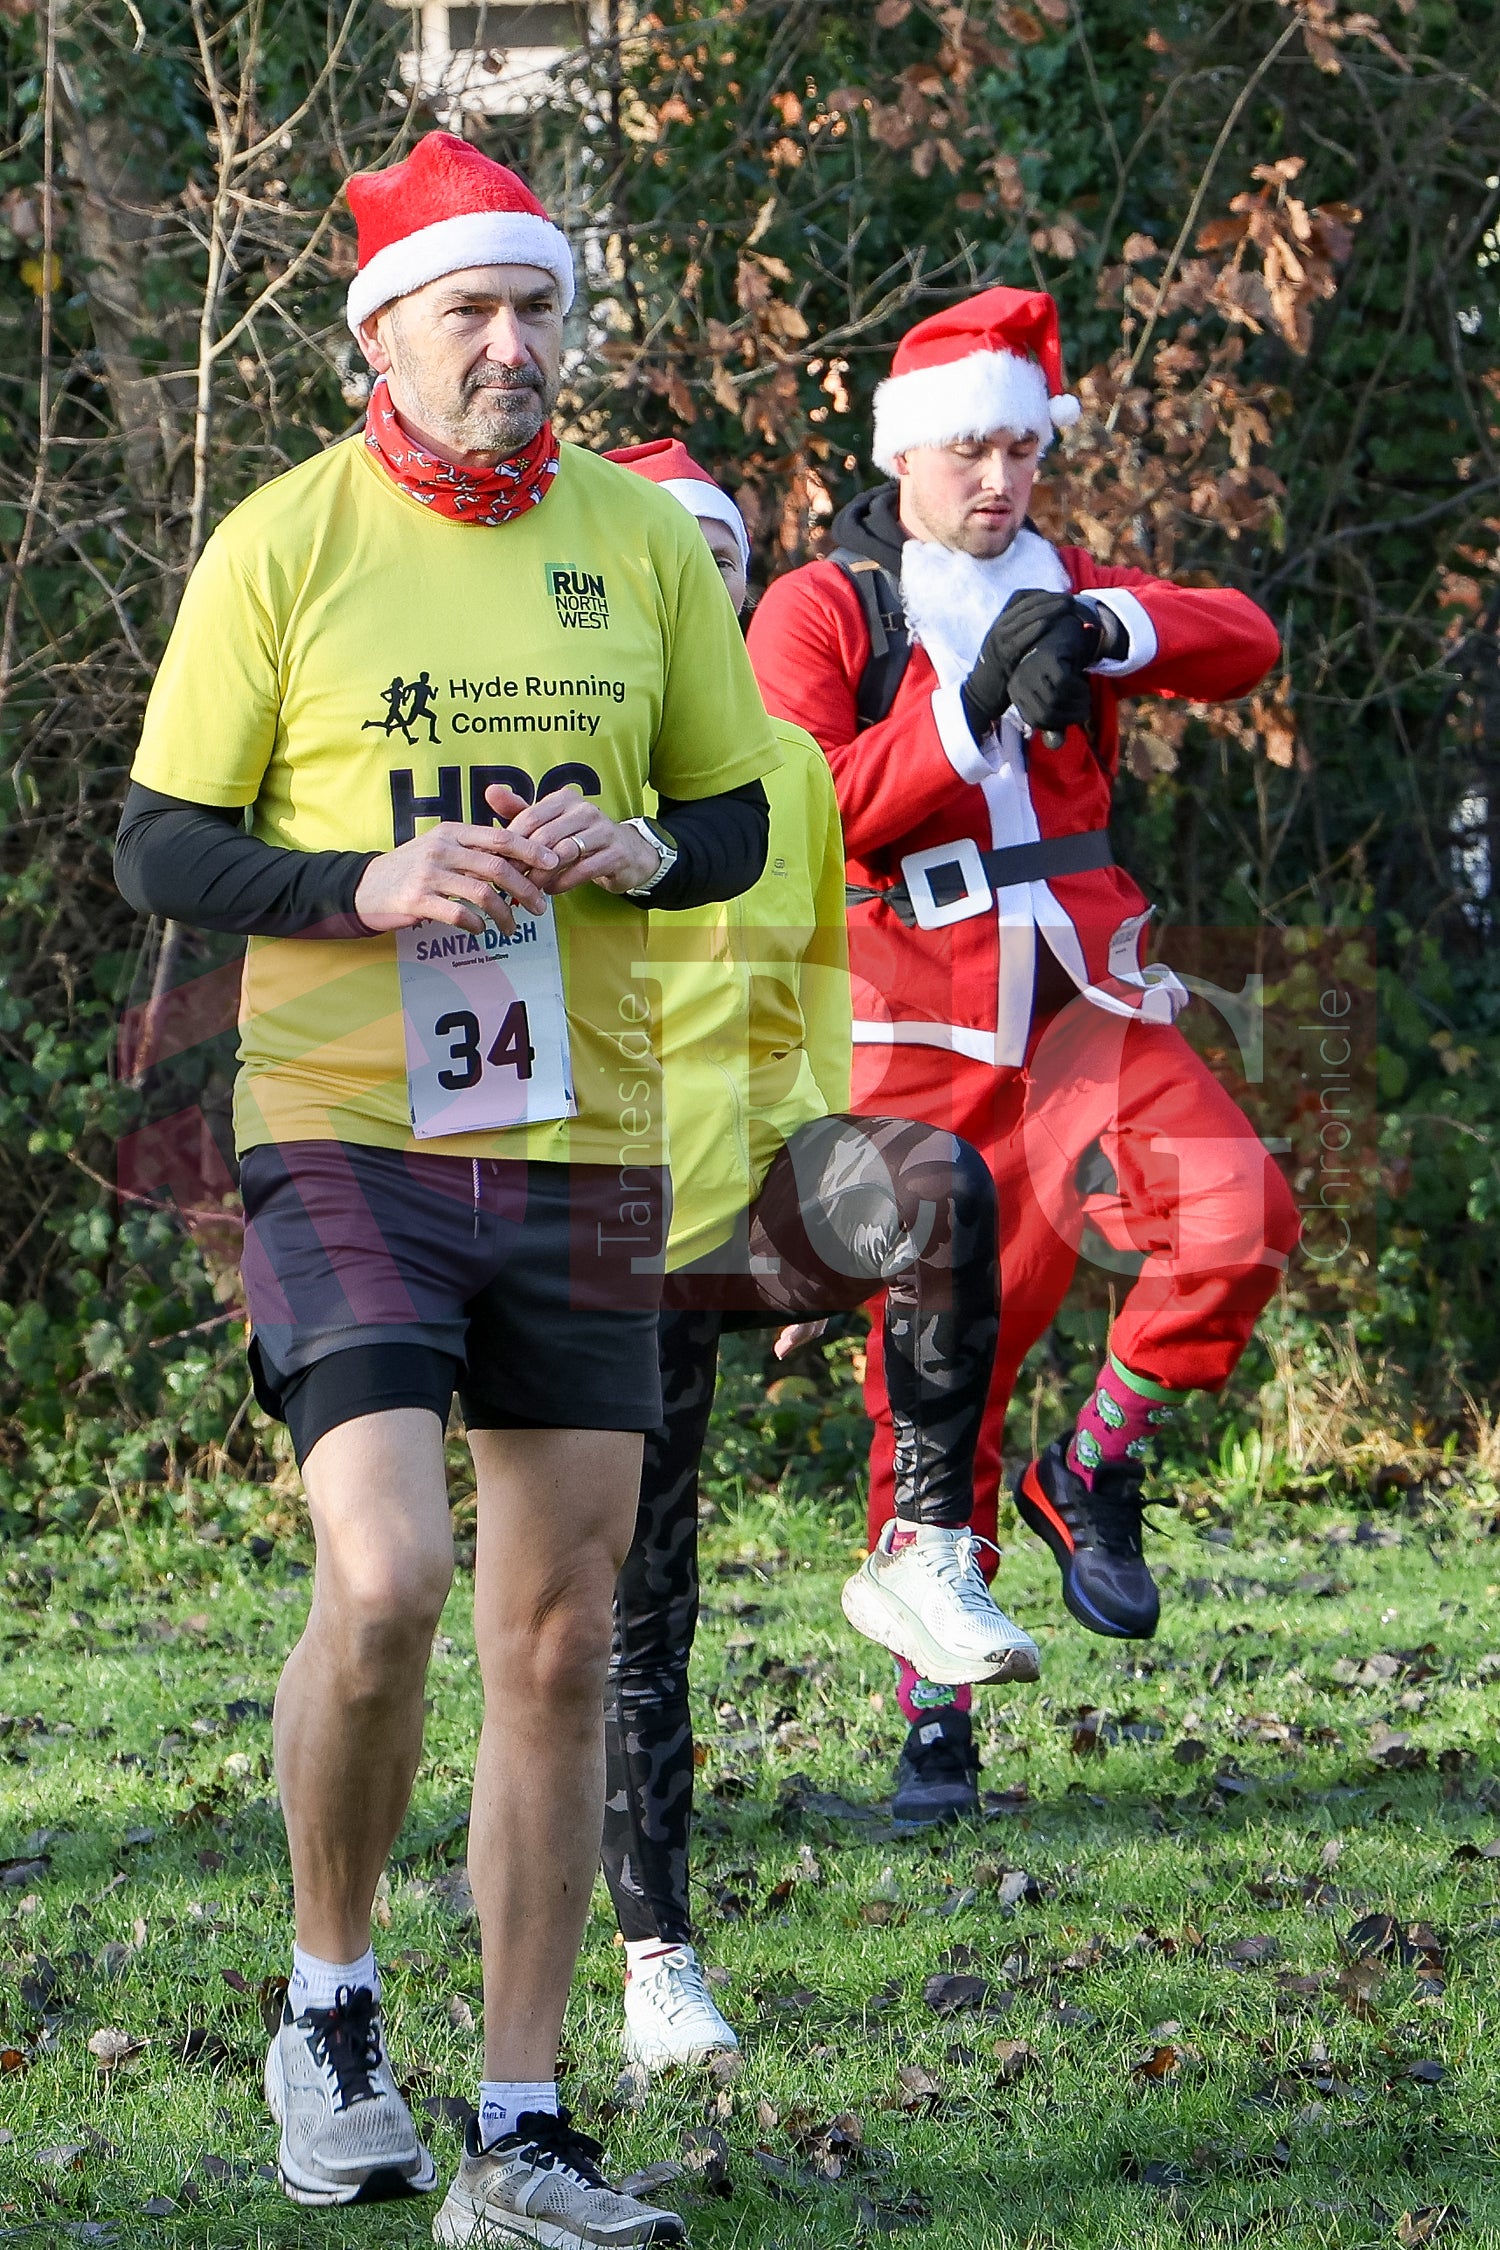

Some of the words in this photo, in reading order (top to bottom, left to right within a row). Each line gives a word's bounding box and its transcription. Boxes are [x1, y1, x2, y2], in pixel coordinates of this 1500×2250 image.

[553, 571, 605, 598] RUN
[555, 596, 609, 614] NORTH
[558, 611, 609, 629] WEST
[449, 676, 518, 703] Hyde
[526, 675, 625, 703] Running
[452, 710, 601, 736] Community
[416, 934, 480, 960] SANTA
[434, 1000, 535, 1090] 34
